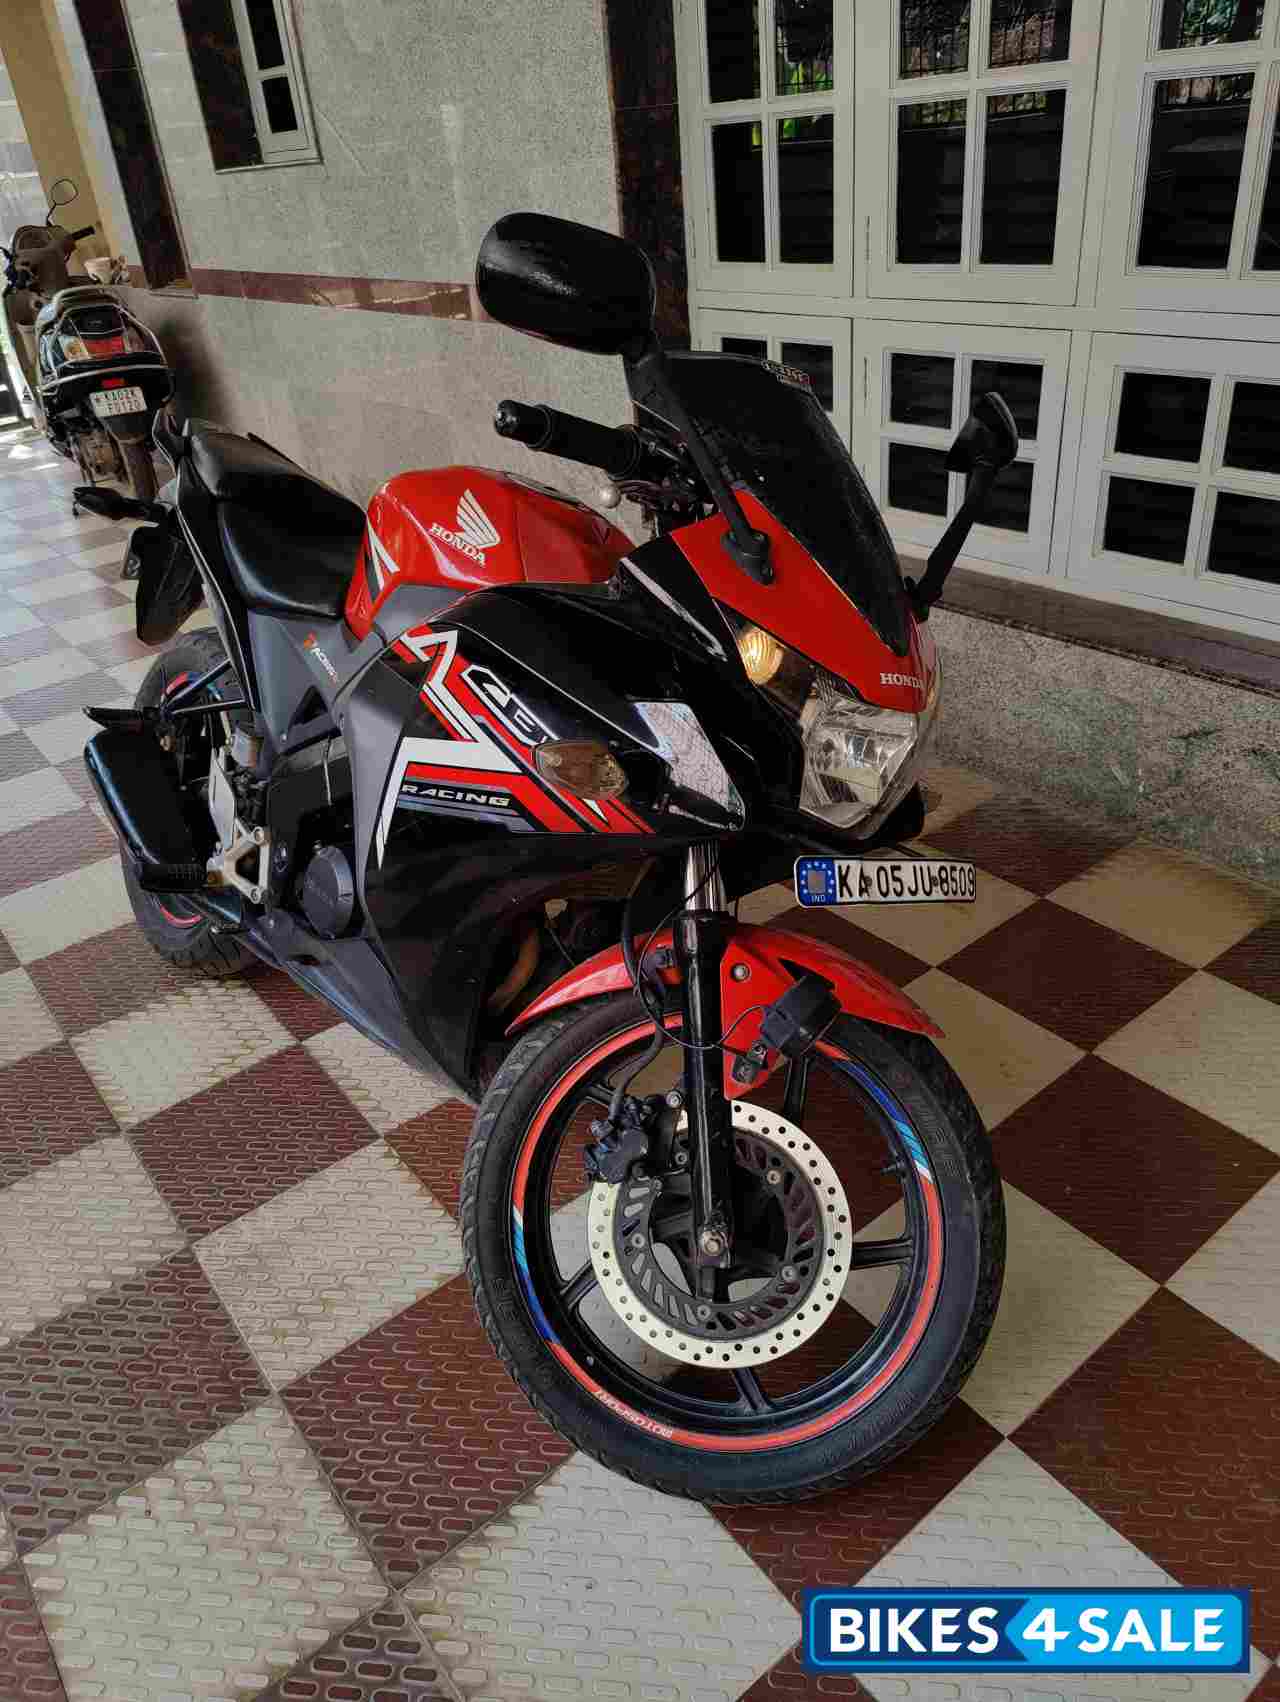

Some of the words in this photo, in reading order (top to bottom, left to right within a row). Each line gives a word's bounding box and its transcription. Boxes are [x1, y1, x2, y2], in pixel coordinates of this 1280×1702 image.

[431, 522, 486, 568] HONDA
[401, 784, 510, 807] RACING
[838, 865, 870, 898] KA
[876, 865, 904, 897] 05
[907, 865, 933, 896] JU
